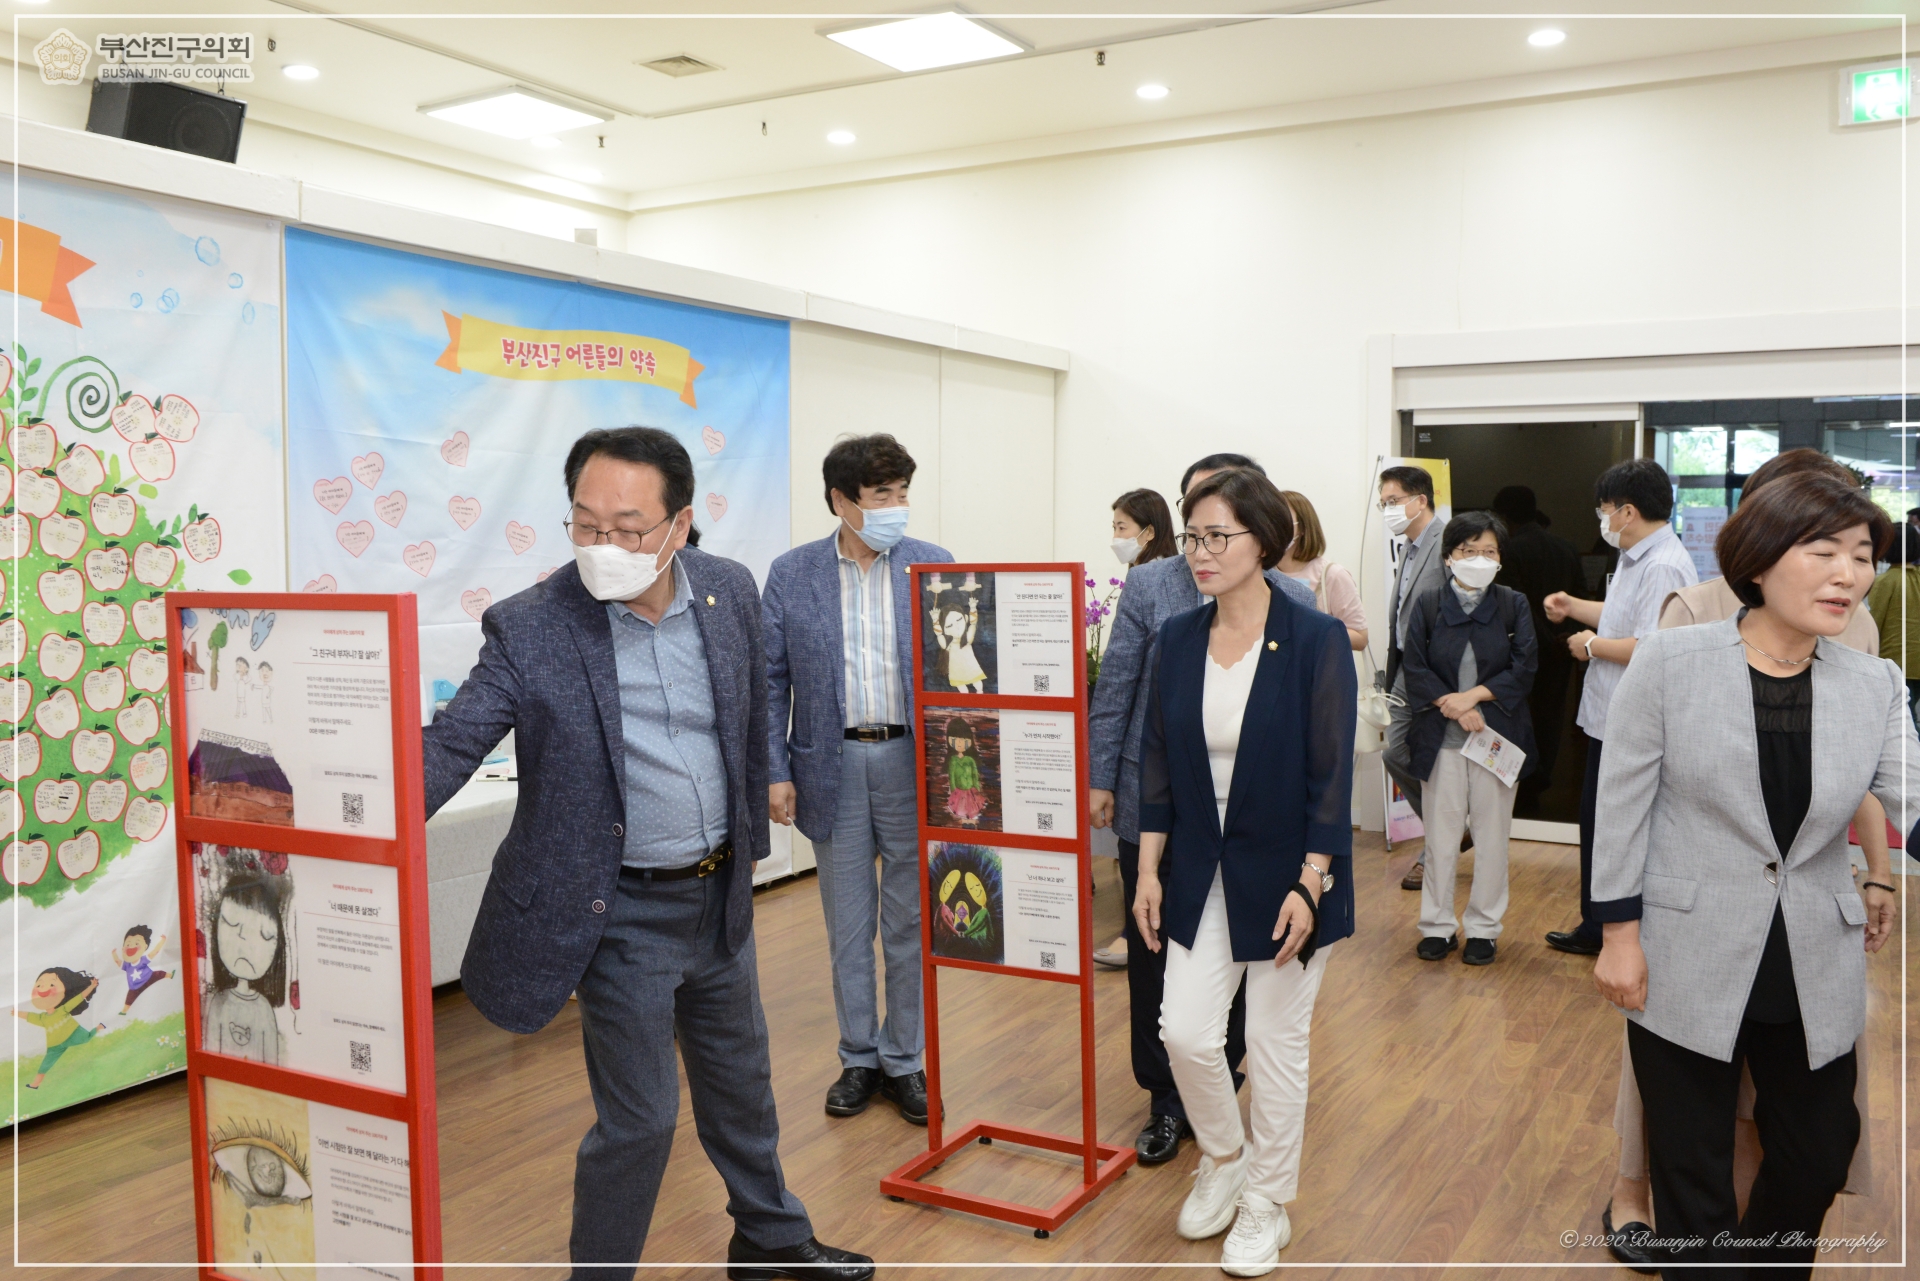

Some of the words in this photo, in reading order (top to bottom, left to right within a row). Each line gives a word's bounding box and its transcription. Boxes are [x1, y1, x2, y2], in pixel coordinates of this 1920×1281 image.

[501, 338, 561, 369] 부산진구
[565, 343, 624, 371] 어른들의
[629, 349, 656, 377] 약속
[319, 648, 336, 658] 친구네
[358, 650, 364, 659] 잘
[337, 903, 354, 913] 때문에
[354, 905, 360, 914] 못
[348, 1145, 353, 1154] 잘
[354, 1146, 365, 1156] 보면
[372, 1150, 390, 1162] 달라는
[390, 1155, 396, 1164] 거
[397, 1156, 404, 1165] 다
